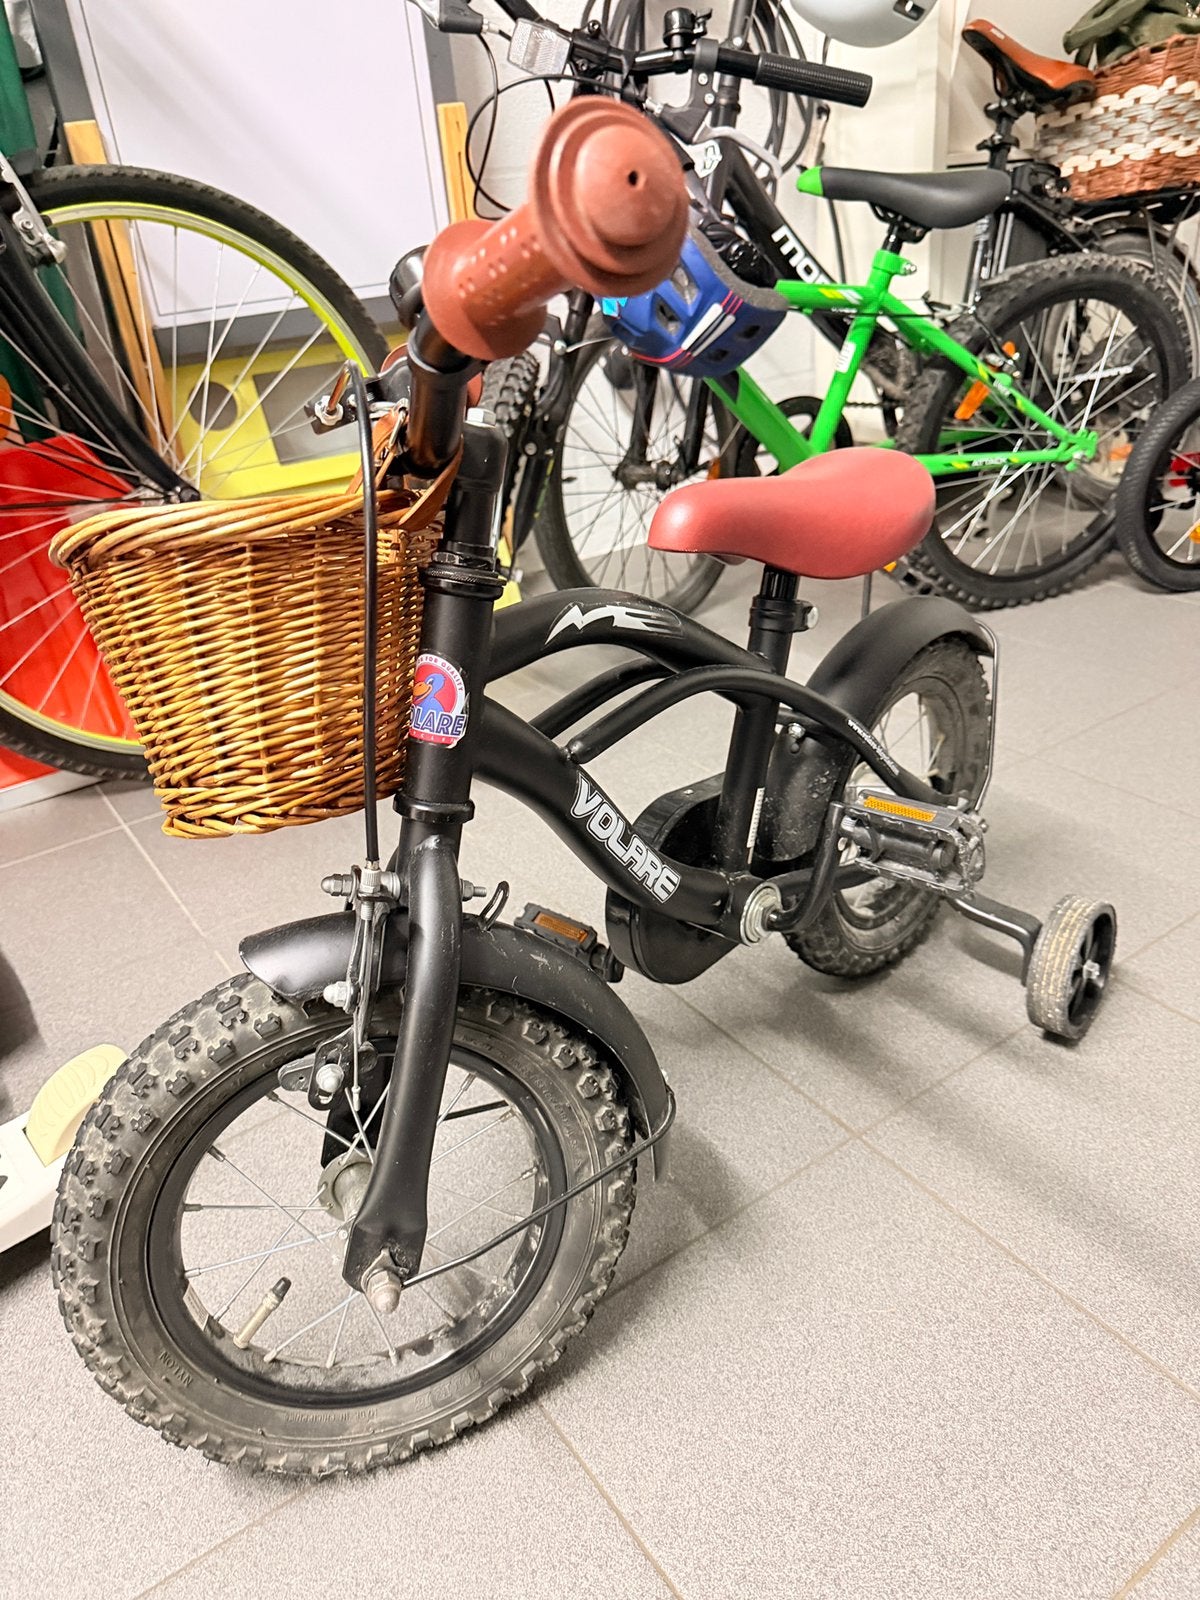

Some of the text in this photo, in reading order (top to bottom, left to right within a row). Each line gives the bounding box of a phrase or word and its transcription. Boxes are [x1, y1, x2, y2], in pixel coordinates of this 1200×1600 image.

[441, 661, 464, 691] QUALITY
[571, 772, 681, 904] VOLARE
[159, 1350, 194, 1388] NYLON
